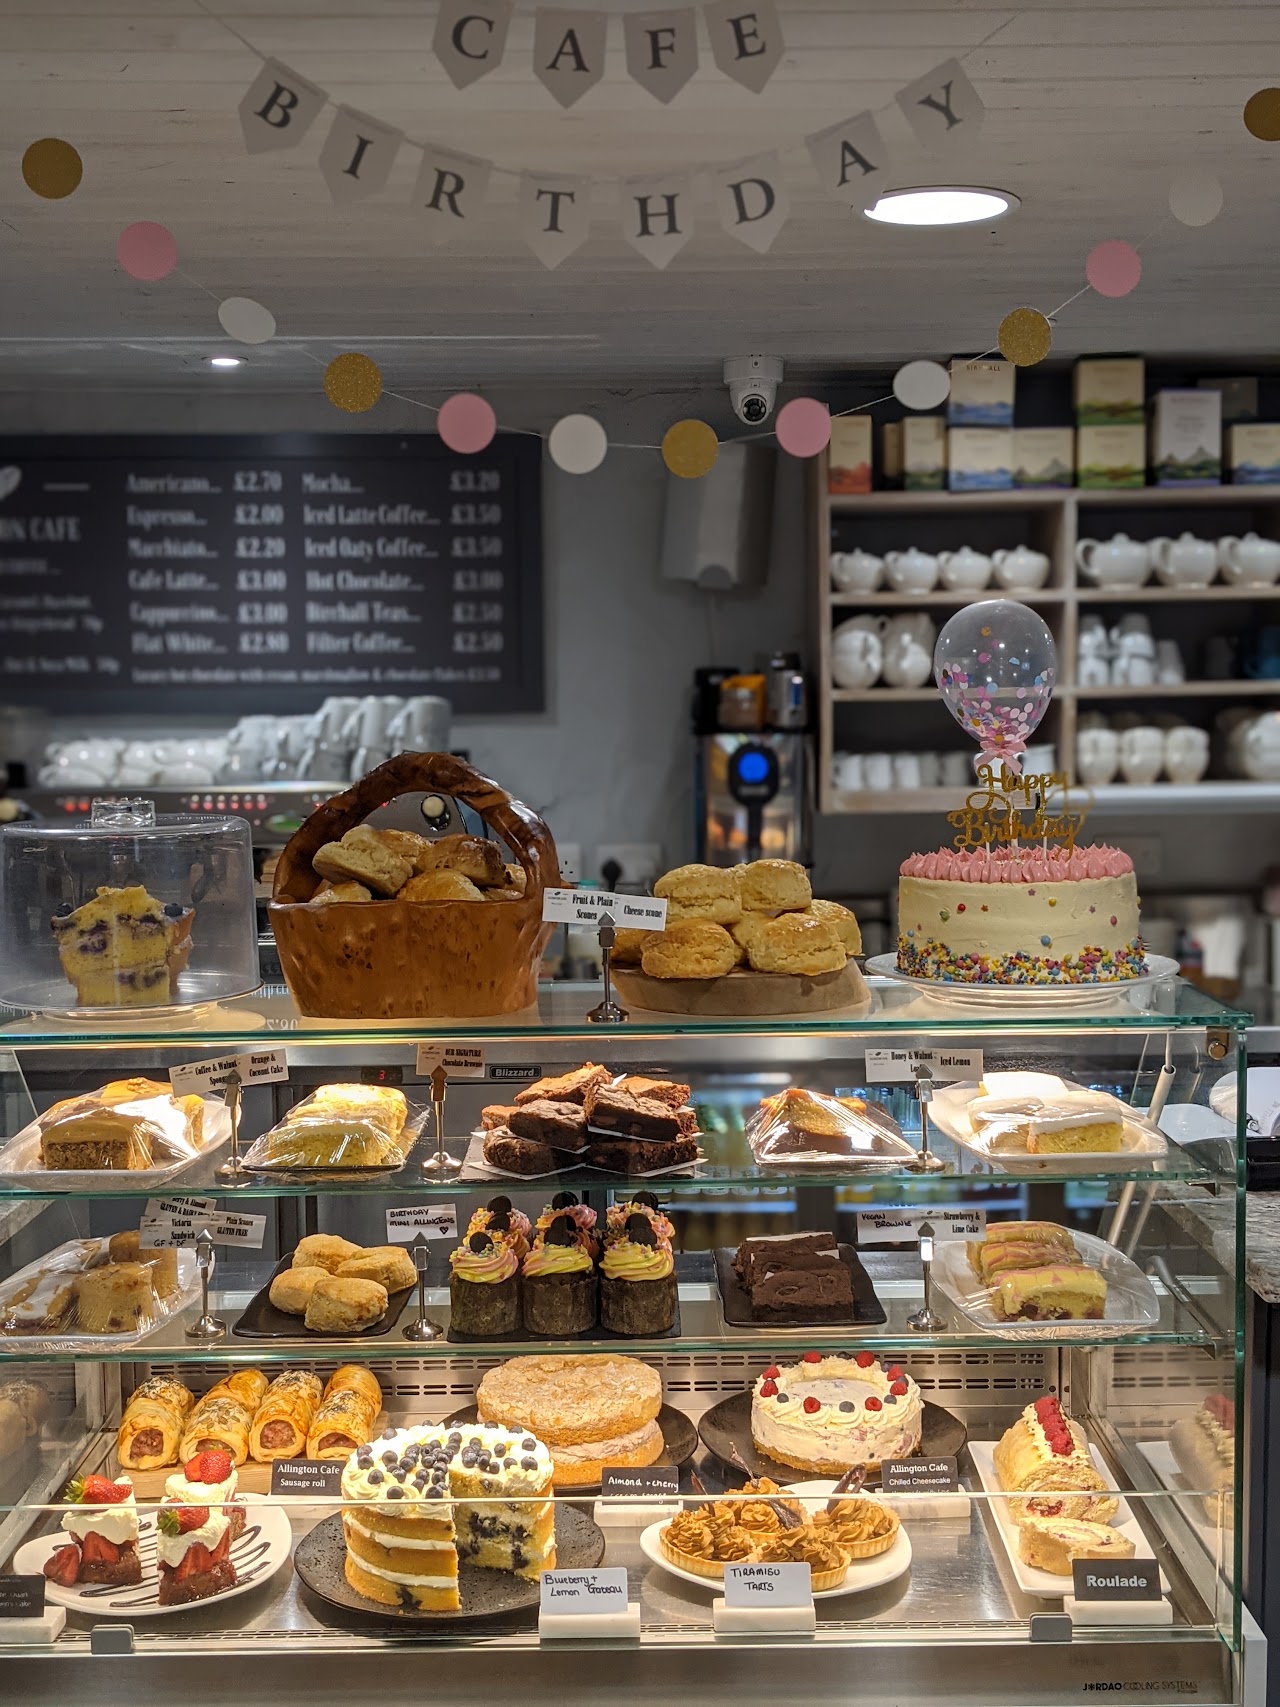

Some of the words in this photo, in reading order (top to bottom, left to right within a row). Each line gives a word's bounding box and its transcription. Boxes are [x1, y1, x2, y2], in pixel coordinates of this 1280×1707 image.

[451, 14, 767, 72] CAFE
[254, 81, 965, 238] BIRTHDAY
[974, 763, 1068, 810] Happy
[947, 800, 1086, 858] Birthday
[572, 894, 588, 905] Fruit
[589, 896, 596, 905] &
[597, 896, 613, 907] Plain
[576, 909, 597, 920] Scones
[624, 905, 644, 917] Cheese
[251, 1056, 270, 1065] Orange
[271, 1053, 276, 1062] &
[908, 1052, 913, 1060] &
[940, 1056, 951, 1065] Iced
[952, 1057, 970, 1066] Lemon
[195, 1064, 211, 1075] Coffee
[212, 1063, 217, 1072] &
[218, 1059, 237, 1071] Walnut
[442, 1059, 463, 1067] Chocolate
[910, 1064, 922, 1072] Loa
[270, 1065, 283, 1075] Cake
[495, 1068, 534, 1077] Blizzard
[209, 1076, 228, 1086] Spong
[390, 1208, 429, 1218] BIRTHDAY
[943, 1211, 974, 1222] Strawberry
[975, 1212, 981, 1220] &
[171, 1218, 192, 1227] Victoria
[225, 1216, 237, 1225] Plain
[414, 1216, 455, 1226] ALLINGTONS
[874, 1220, 912, 1228] BROWNIE
[217, 1226, 234, 1236] GLUTEN
[952, 1225, 965, 1233] Lime
[965, 1225, 979, 1233] Cake
[171, 1230, 195, 1240] Sandwich
[154, 1239, 165, 1247] GF
[176, 1239, 186, 1247] DF
[277, 1464, 318, 1475] Allington
[320, 1465, 340, 1474] Cafe
[889, 1464, 928, 1474] Allington
[928, 1463, 948, 1472] Cafe
[280, 1478, 311, 1488] Sausage
[312, 1479, 326, 1487] roll
[607, 1476, 643, 1486] Almond
[889, 1478, 911, 1486] Chilled
[912, 1477, 951, 1485] Cheesecake
[730, 1567, 781, 1578] TIRAMISU
[545, 1574, 589, 1587] Blueberry
[591, 1575, 598, 1583] +
[1086, 1575, 1147, 1587] Roulade
[550, 1587, 580, 1597] Lemon
[588, 1583, 623, 1594] Gateau
[743, 1581, 774, 1592] TARTS
[1123, 1682, 1159, 1690] COOLING
[1161, 1680, 1198, 1690] SYSTEMS
